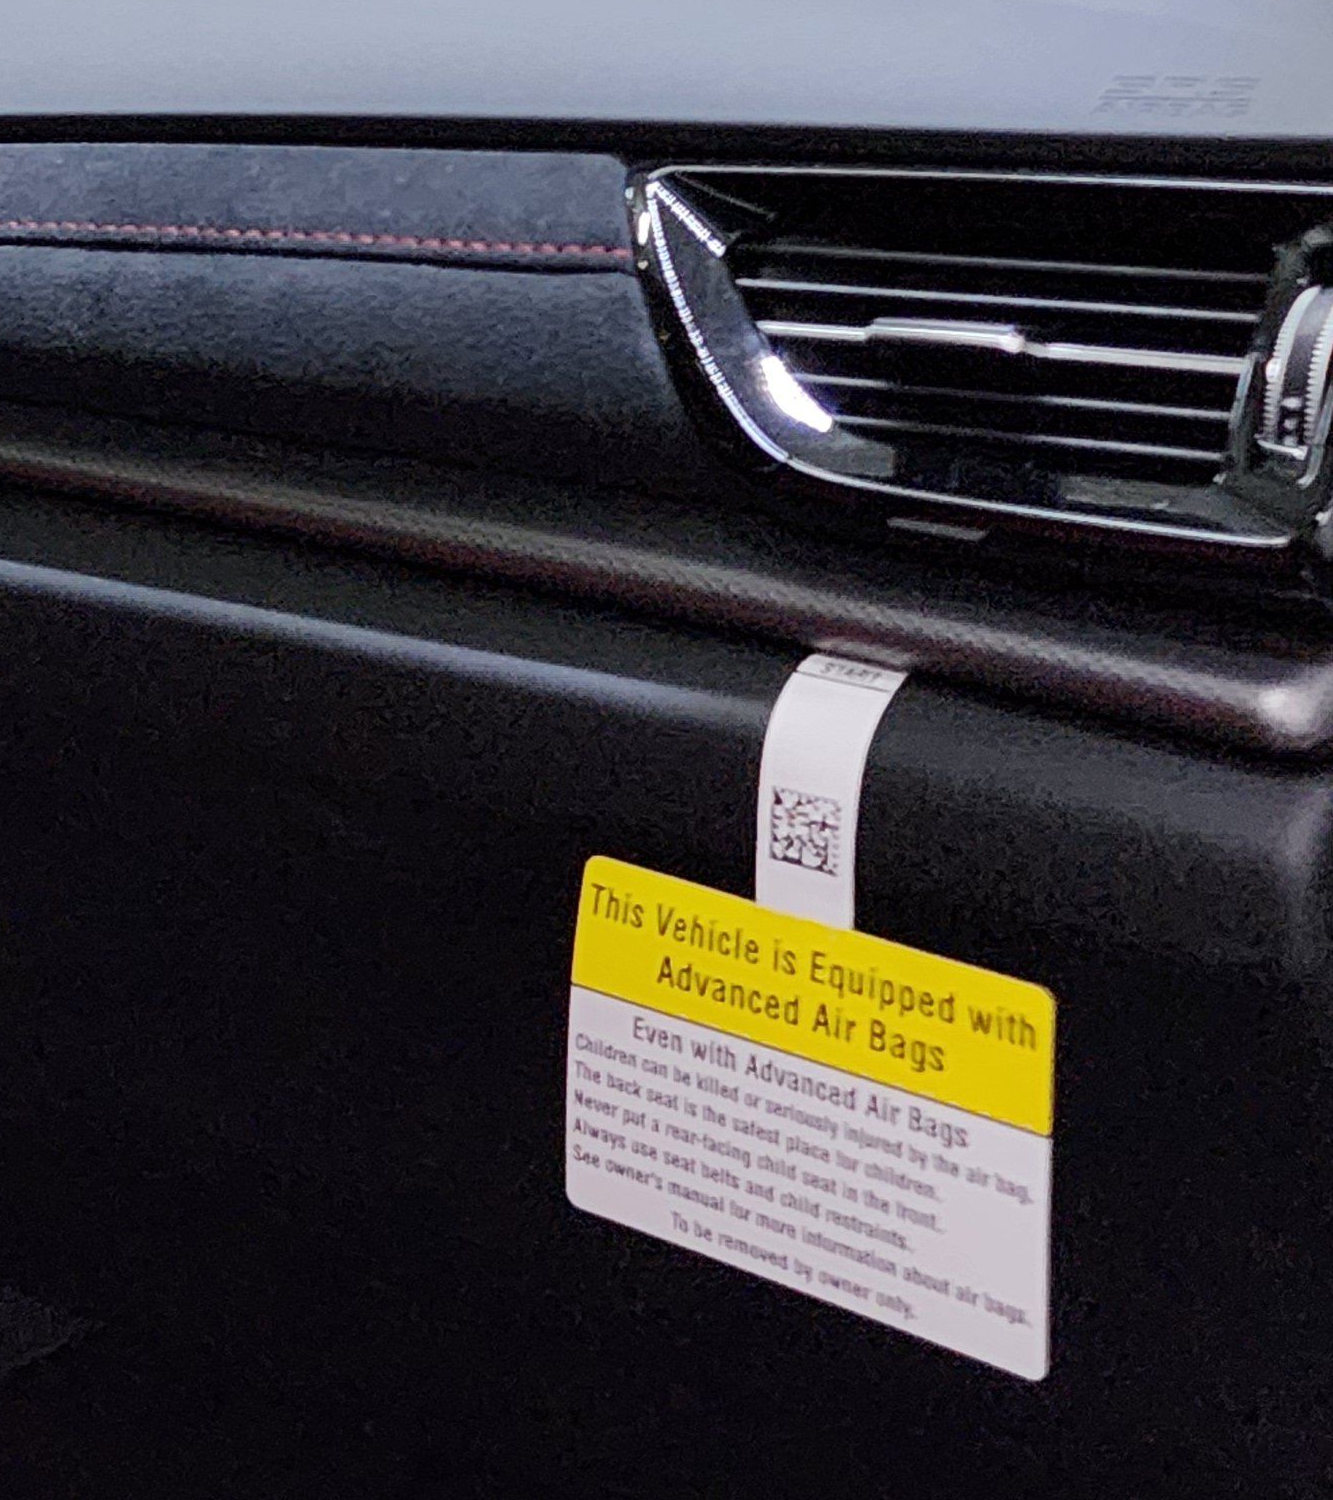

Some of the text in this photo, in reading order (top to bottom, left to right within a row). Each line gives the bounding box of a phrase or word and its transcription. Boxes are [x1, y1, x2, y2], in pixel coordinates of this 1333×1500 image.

[591, 882, 1037, 1051] This Vehicle is Equipped with
[656, 955, 946, 1073] Advanced Air Bags
[574, 1031, 1035, 1206] Children can be killed or seriously injured by the air bag.
[574, 1059, 944, 1203] The back seat is the safest place for children.
[632, 1015, 970, 1149] Even with Advanced Air Bags
[572, 1117, 914, 1253] Always use seat belts and child restraints.
[574, 1088, 947, 1235] Never put a rear-facing child seat in the front.
[572, 1143, 1033, 1328] See owner's manual for more information about air bags.
[670, 1209, 918, 1321] To be removed by owner only.
